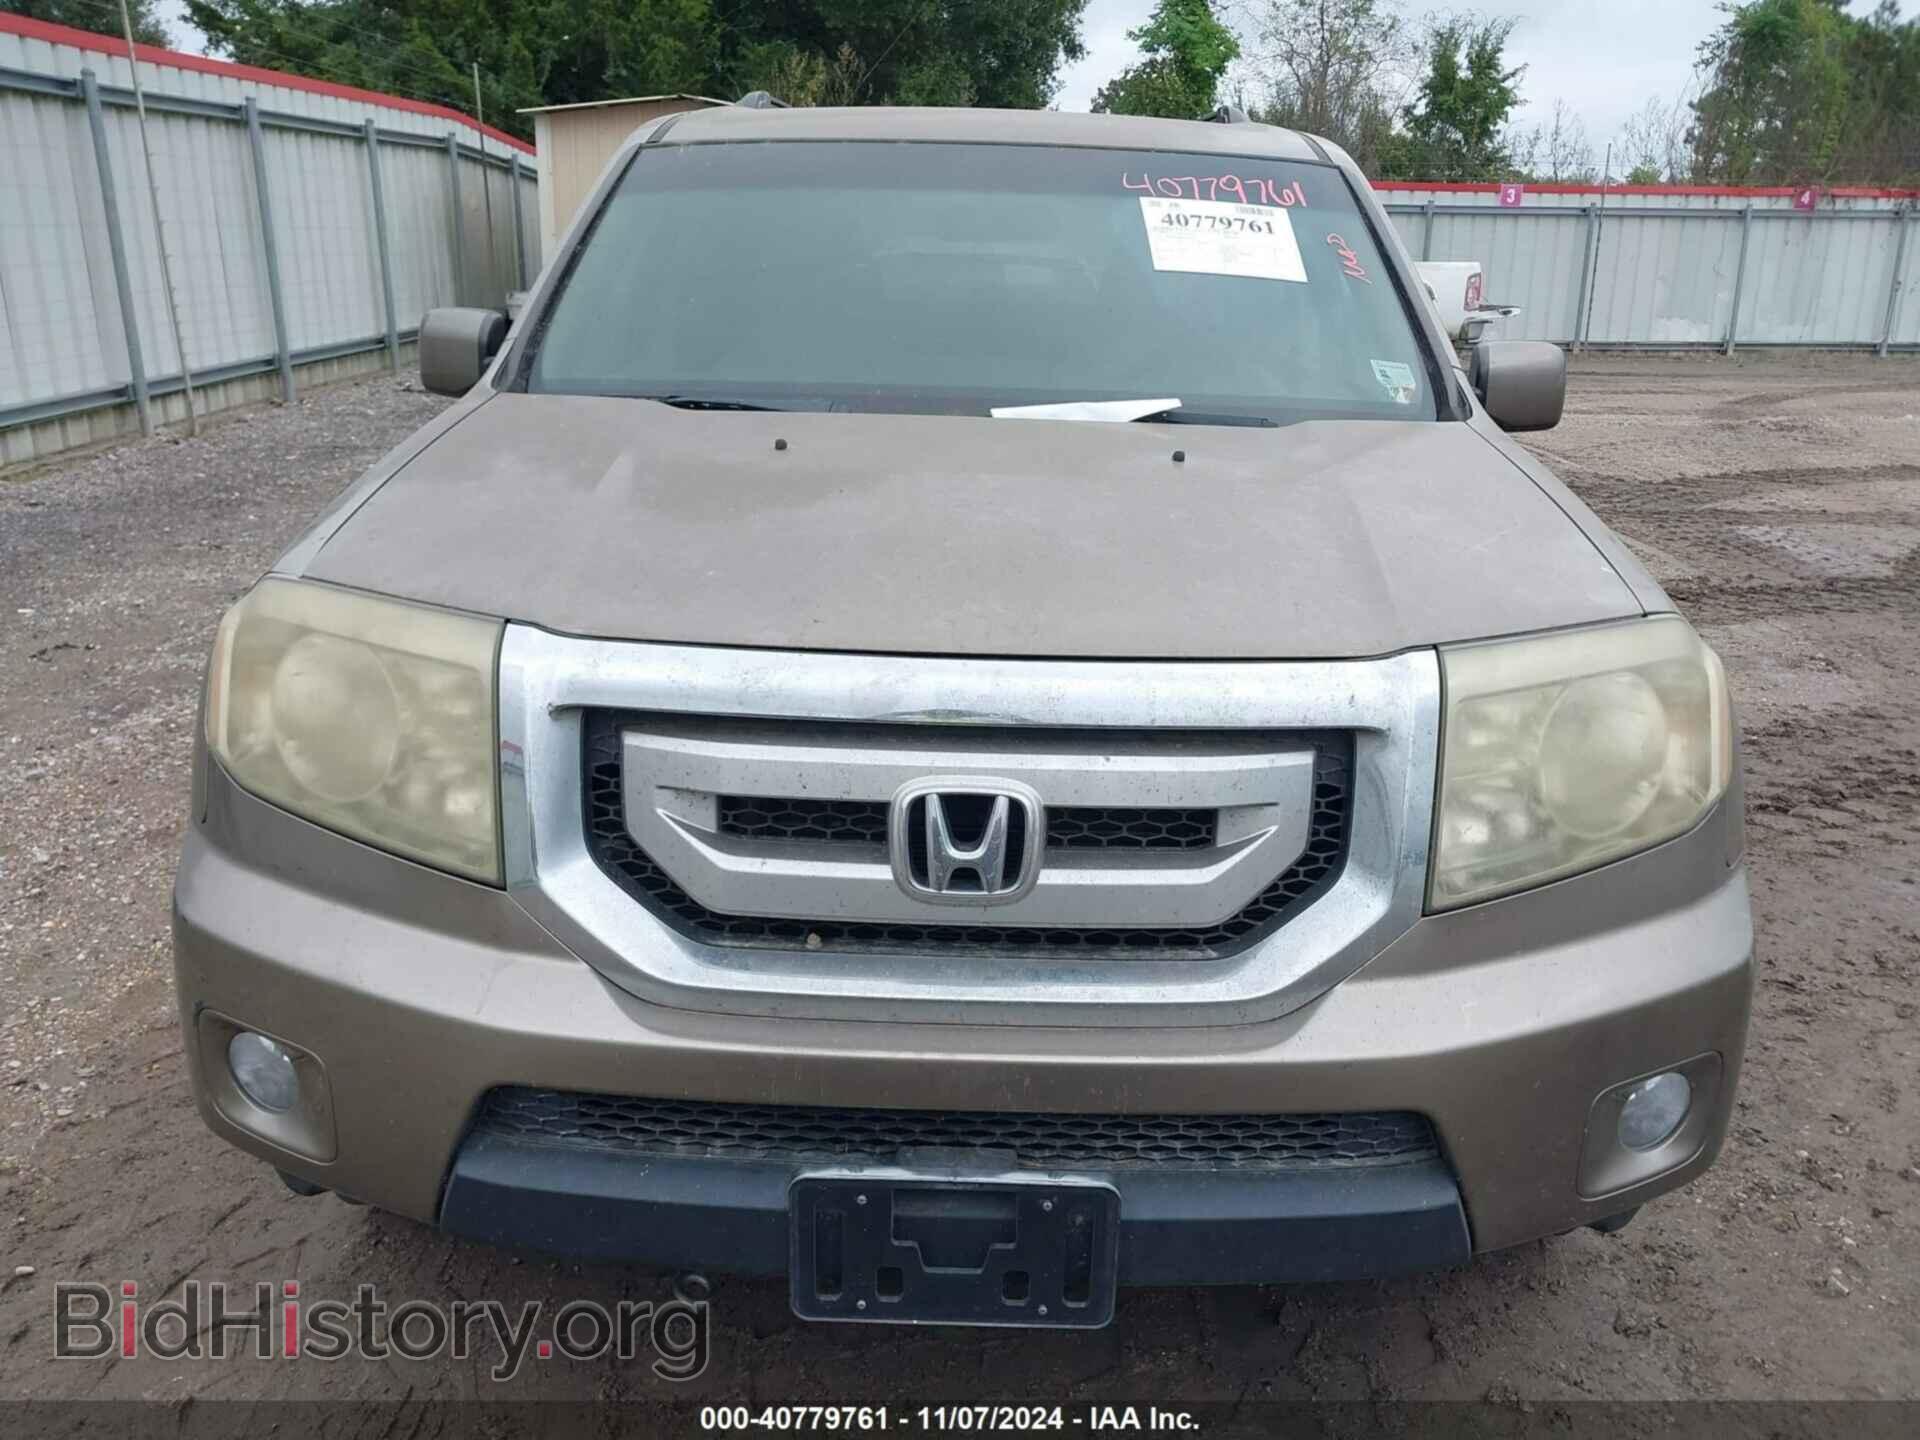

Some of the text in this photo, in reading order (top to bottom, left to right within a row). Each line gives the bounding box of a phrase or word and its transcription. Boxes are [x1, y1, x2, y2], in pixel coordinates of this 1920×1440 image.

[1122, 172, 1308, 208] 40779761
[1506, 188, 1516, 203] 3
[1800, 190, 1810, 205] 4
[1160, 212, 1276, 236] 40779761
